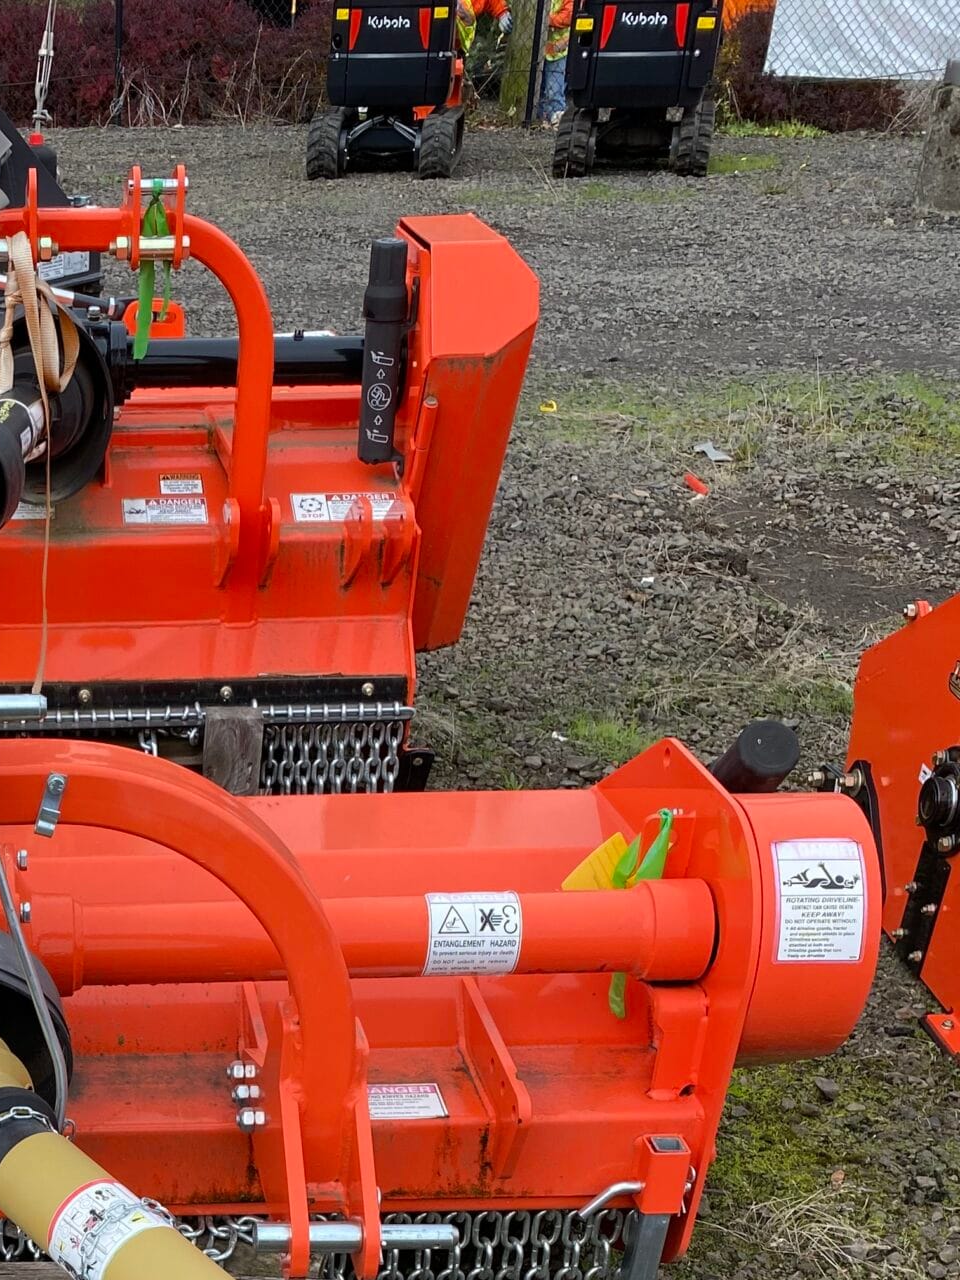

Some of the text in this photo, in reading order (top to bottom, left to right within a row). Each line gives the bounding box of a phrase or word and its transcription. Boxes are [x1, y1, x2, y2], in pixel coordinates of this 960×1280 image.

[368, 16, 410, 28] Kubota
[622, 12, 668, 26] Kubota
[433, 940, 486, 948] ENTANGLEMENT
